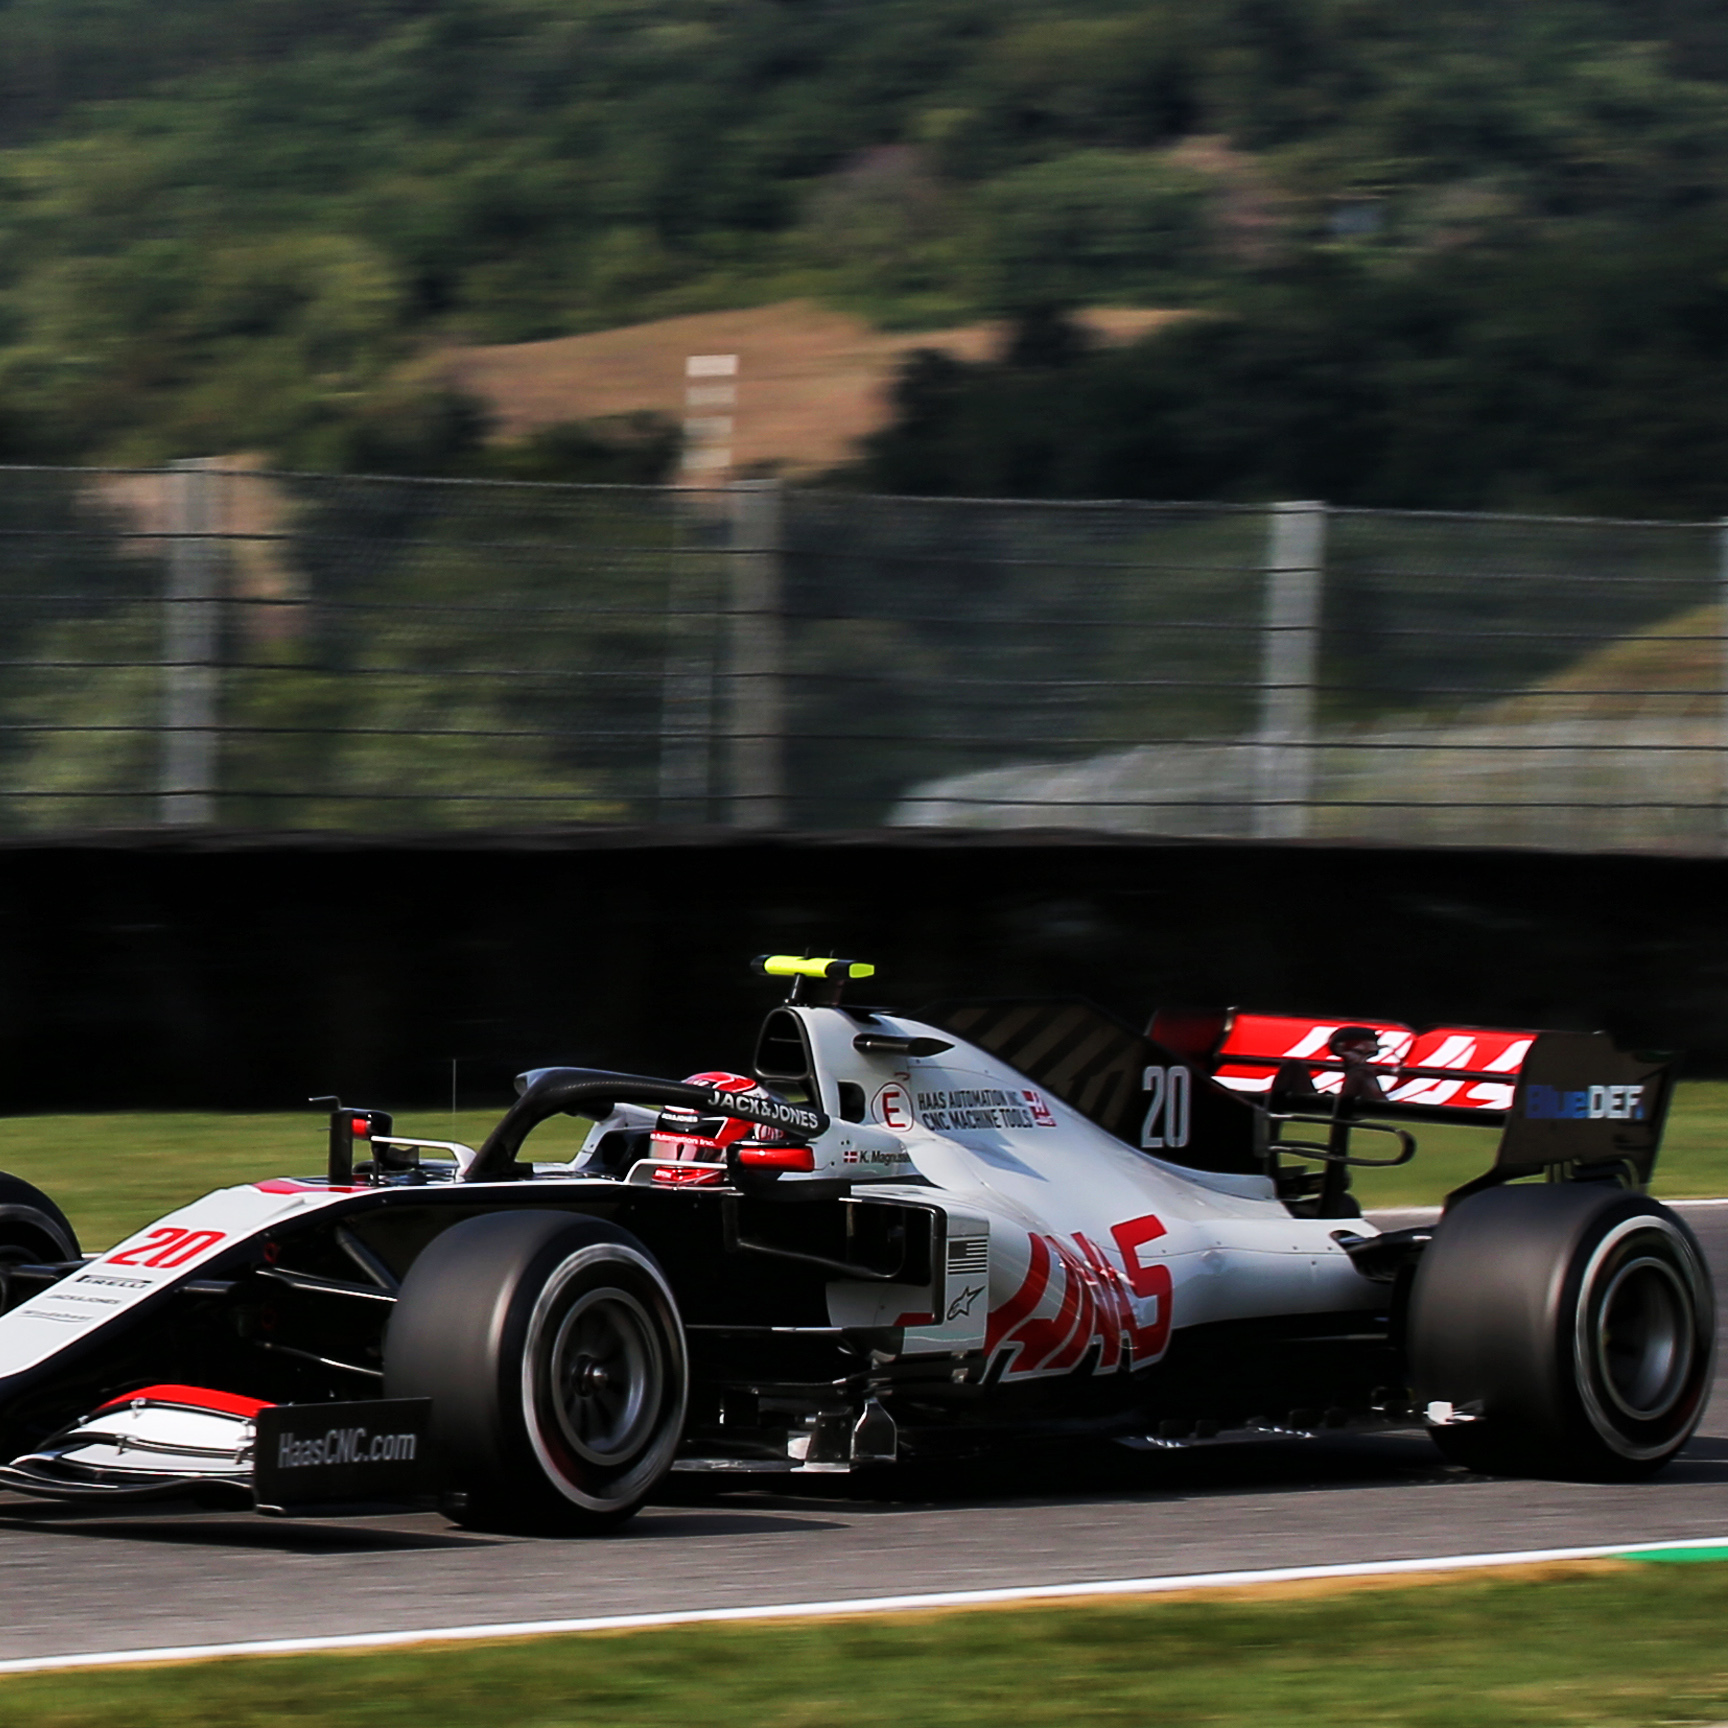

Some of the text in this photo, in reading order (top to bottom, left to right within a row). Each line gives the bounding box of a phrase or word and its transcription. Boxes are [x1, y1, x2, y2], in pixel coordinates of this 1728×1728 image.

[708, 1091, 819, 1129] JACK&JONES
[882, 1091, 906, 1128] E
[917, 1091, 947, 1111] HAAS
[947, 1089, 1011, 1109] AUTOMATION
[1141, 1065, 1191, 1148] 20
[922, 1112, 951, 1132] CNC
[948, 1110, 1002, 1130] MACHINE
[998, 1108, 1034, 1128] TOOLS
[859, 1150, 870, 1164] K.
[105, 1227, 229, 1269] 20
[74, 1274, 154, 1290] PIRELLI
[278, 1426, 417, 1470] HaasCNC.com
